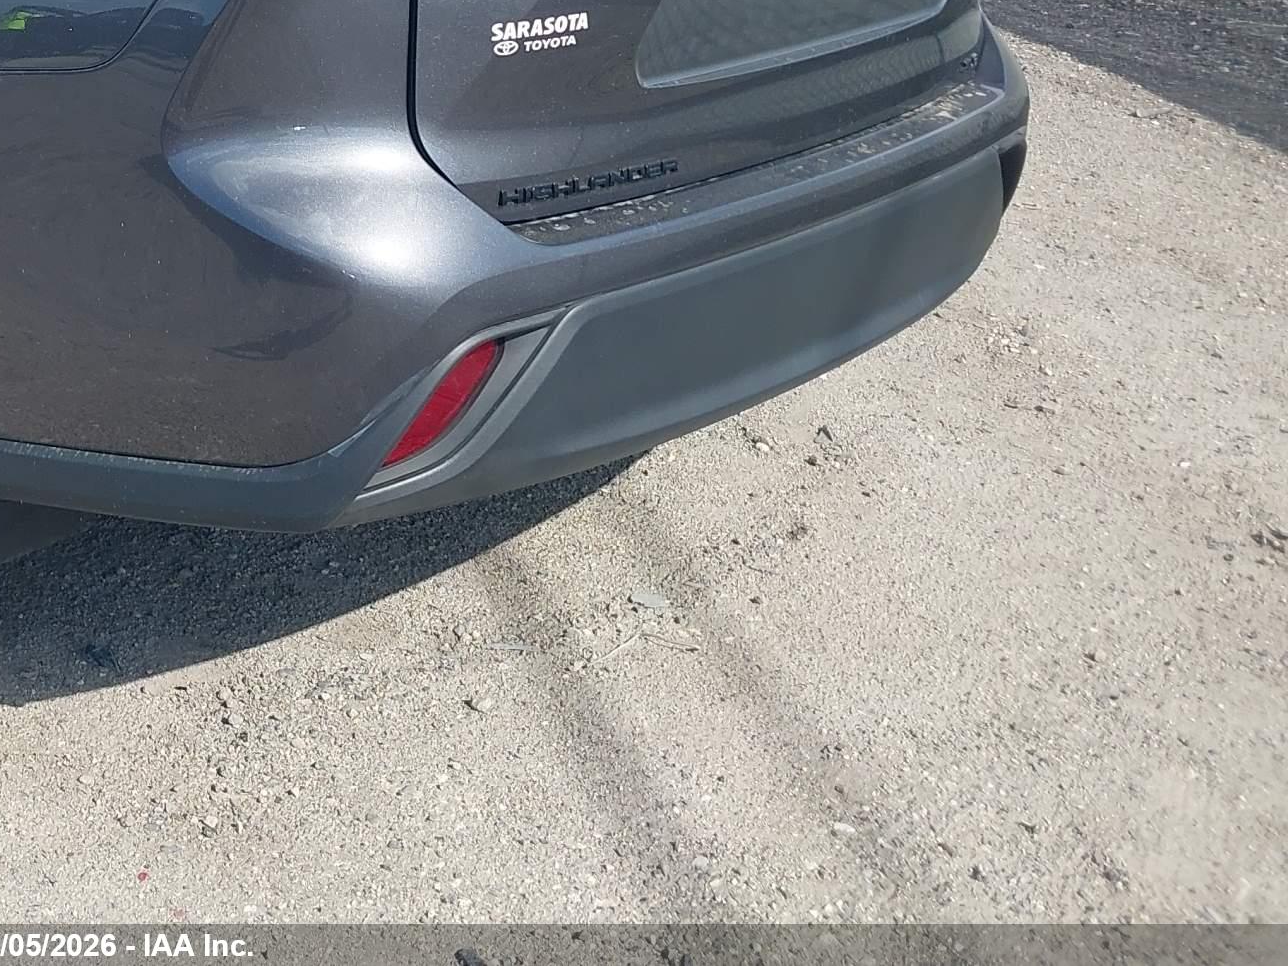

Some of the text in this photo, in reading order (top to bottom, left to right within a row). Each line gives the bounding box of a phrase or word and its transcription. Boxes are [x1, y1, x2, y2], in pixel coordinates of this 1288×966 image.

[491, 12, 589, 41] SARASOTA
[523, 35, 576, 52] TOYOTA
[498, 159, 679, 207] HIGHLANDER
